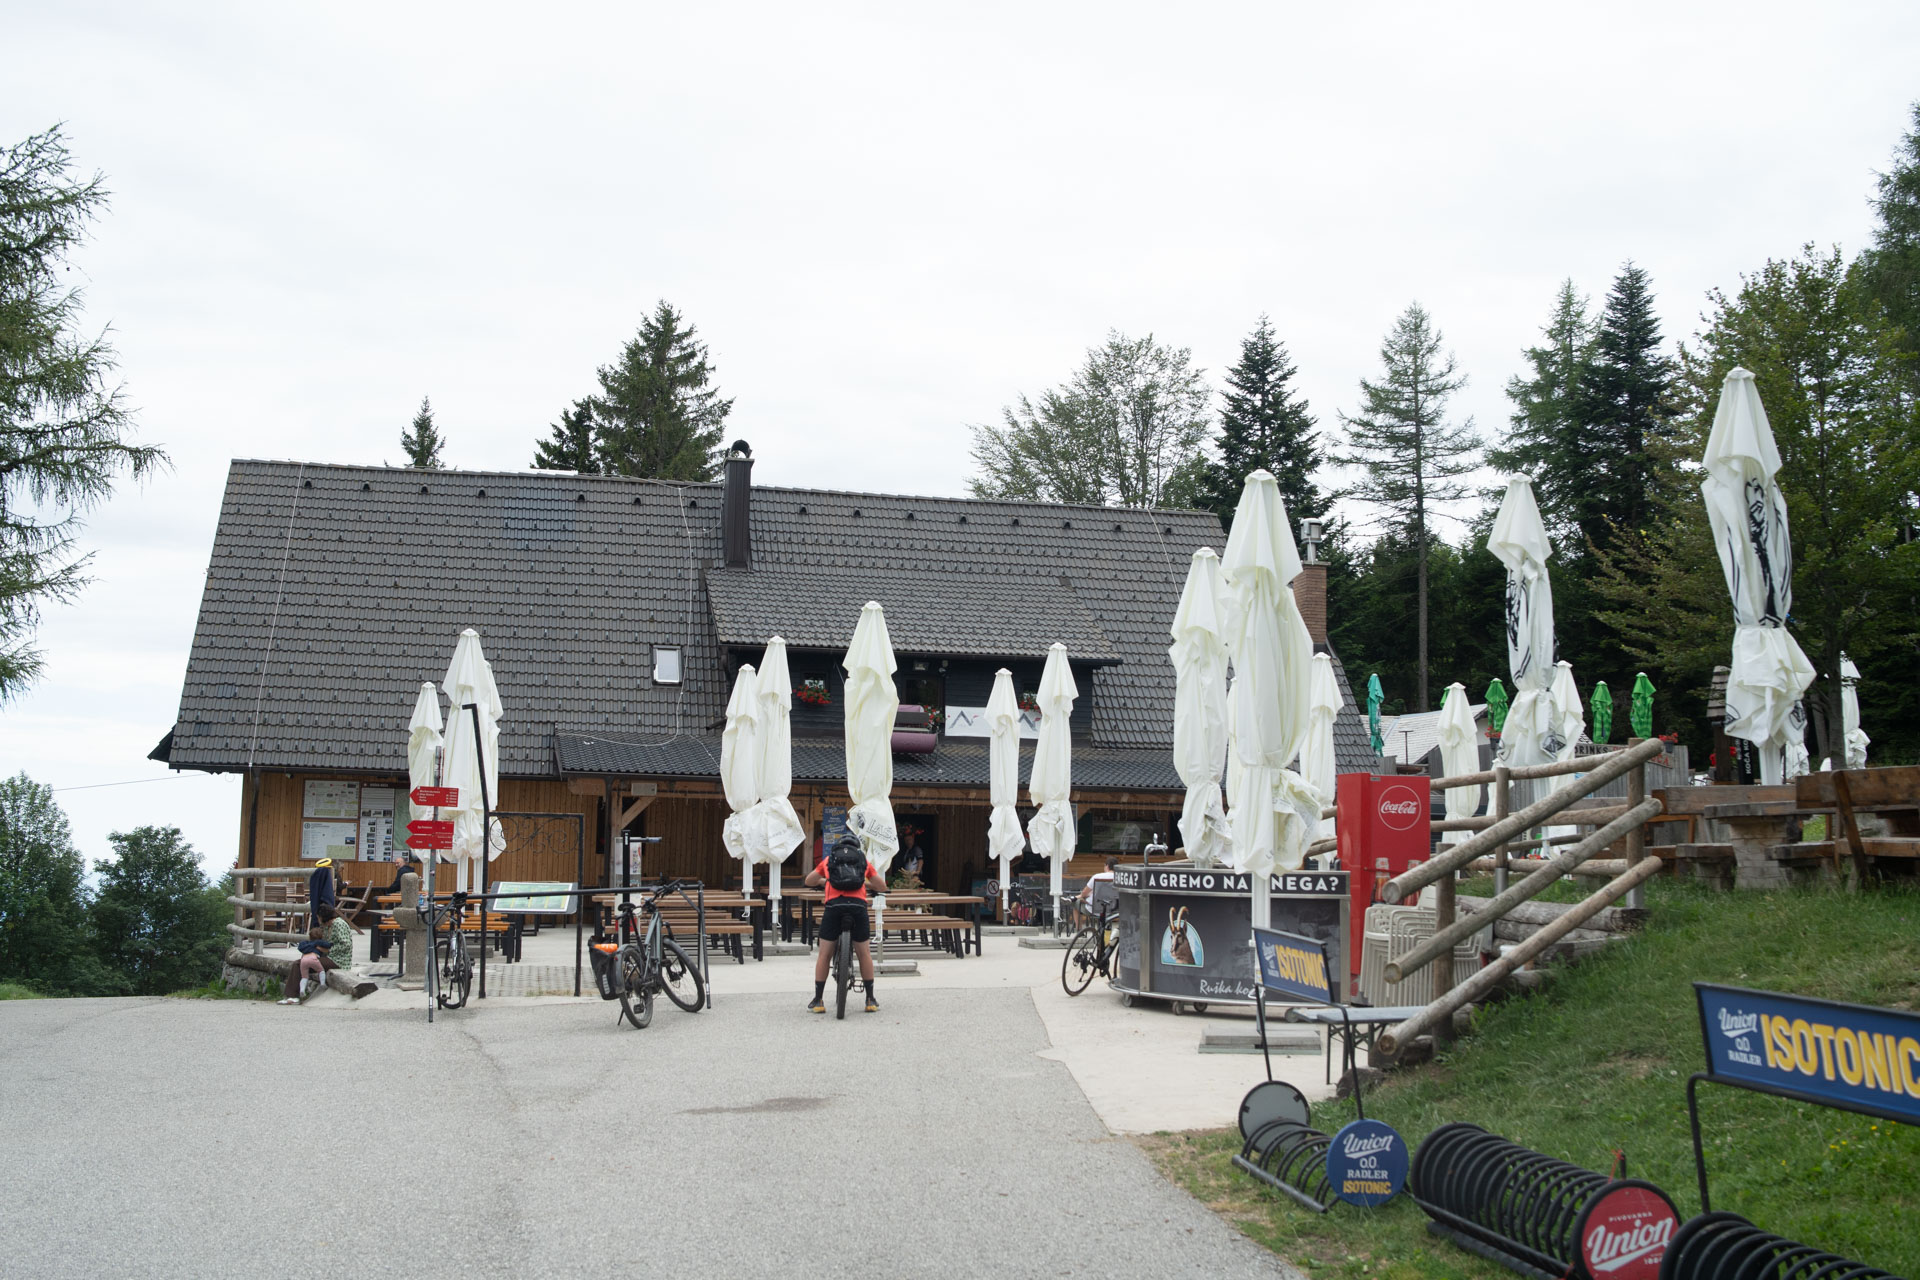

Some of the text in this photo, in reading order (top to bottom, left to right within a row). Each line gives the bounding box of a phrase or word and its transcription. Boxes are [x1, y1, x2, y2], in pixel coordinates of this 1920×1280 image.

[1381, 801, 1418, 814] Coca-Cola
[1149, 874, 1339, 891] A GREMO NA NEGA?
[1275, 944, 1329, 991] ISOTONIC
[1718, 1007, 1758, 1033] Union
[1760, 1014, 1920, 1100] ISOTONIC
[1343, 1133, 1394, 1154] Union
[1347, 1169, 1389, 1180] RADLER
[1343, 1181, 1392, 1195] ISOTONIC
[1587, 1217, 1673, 1265] Union
